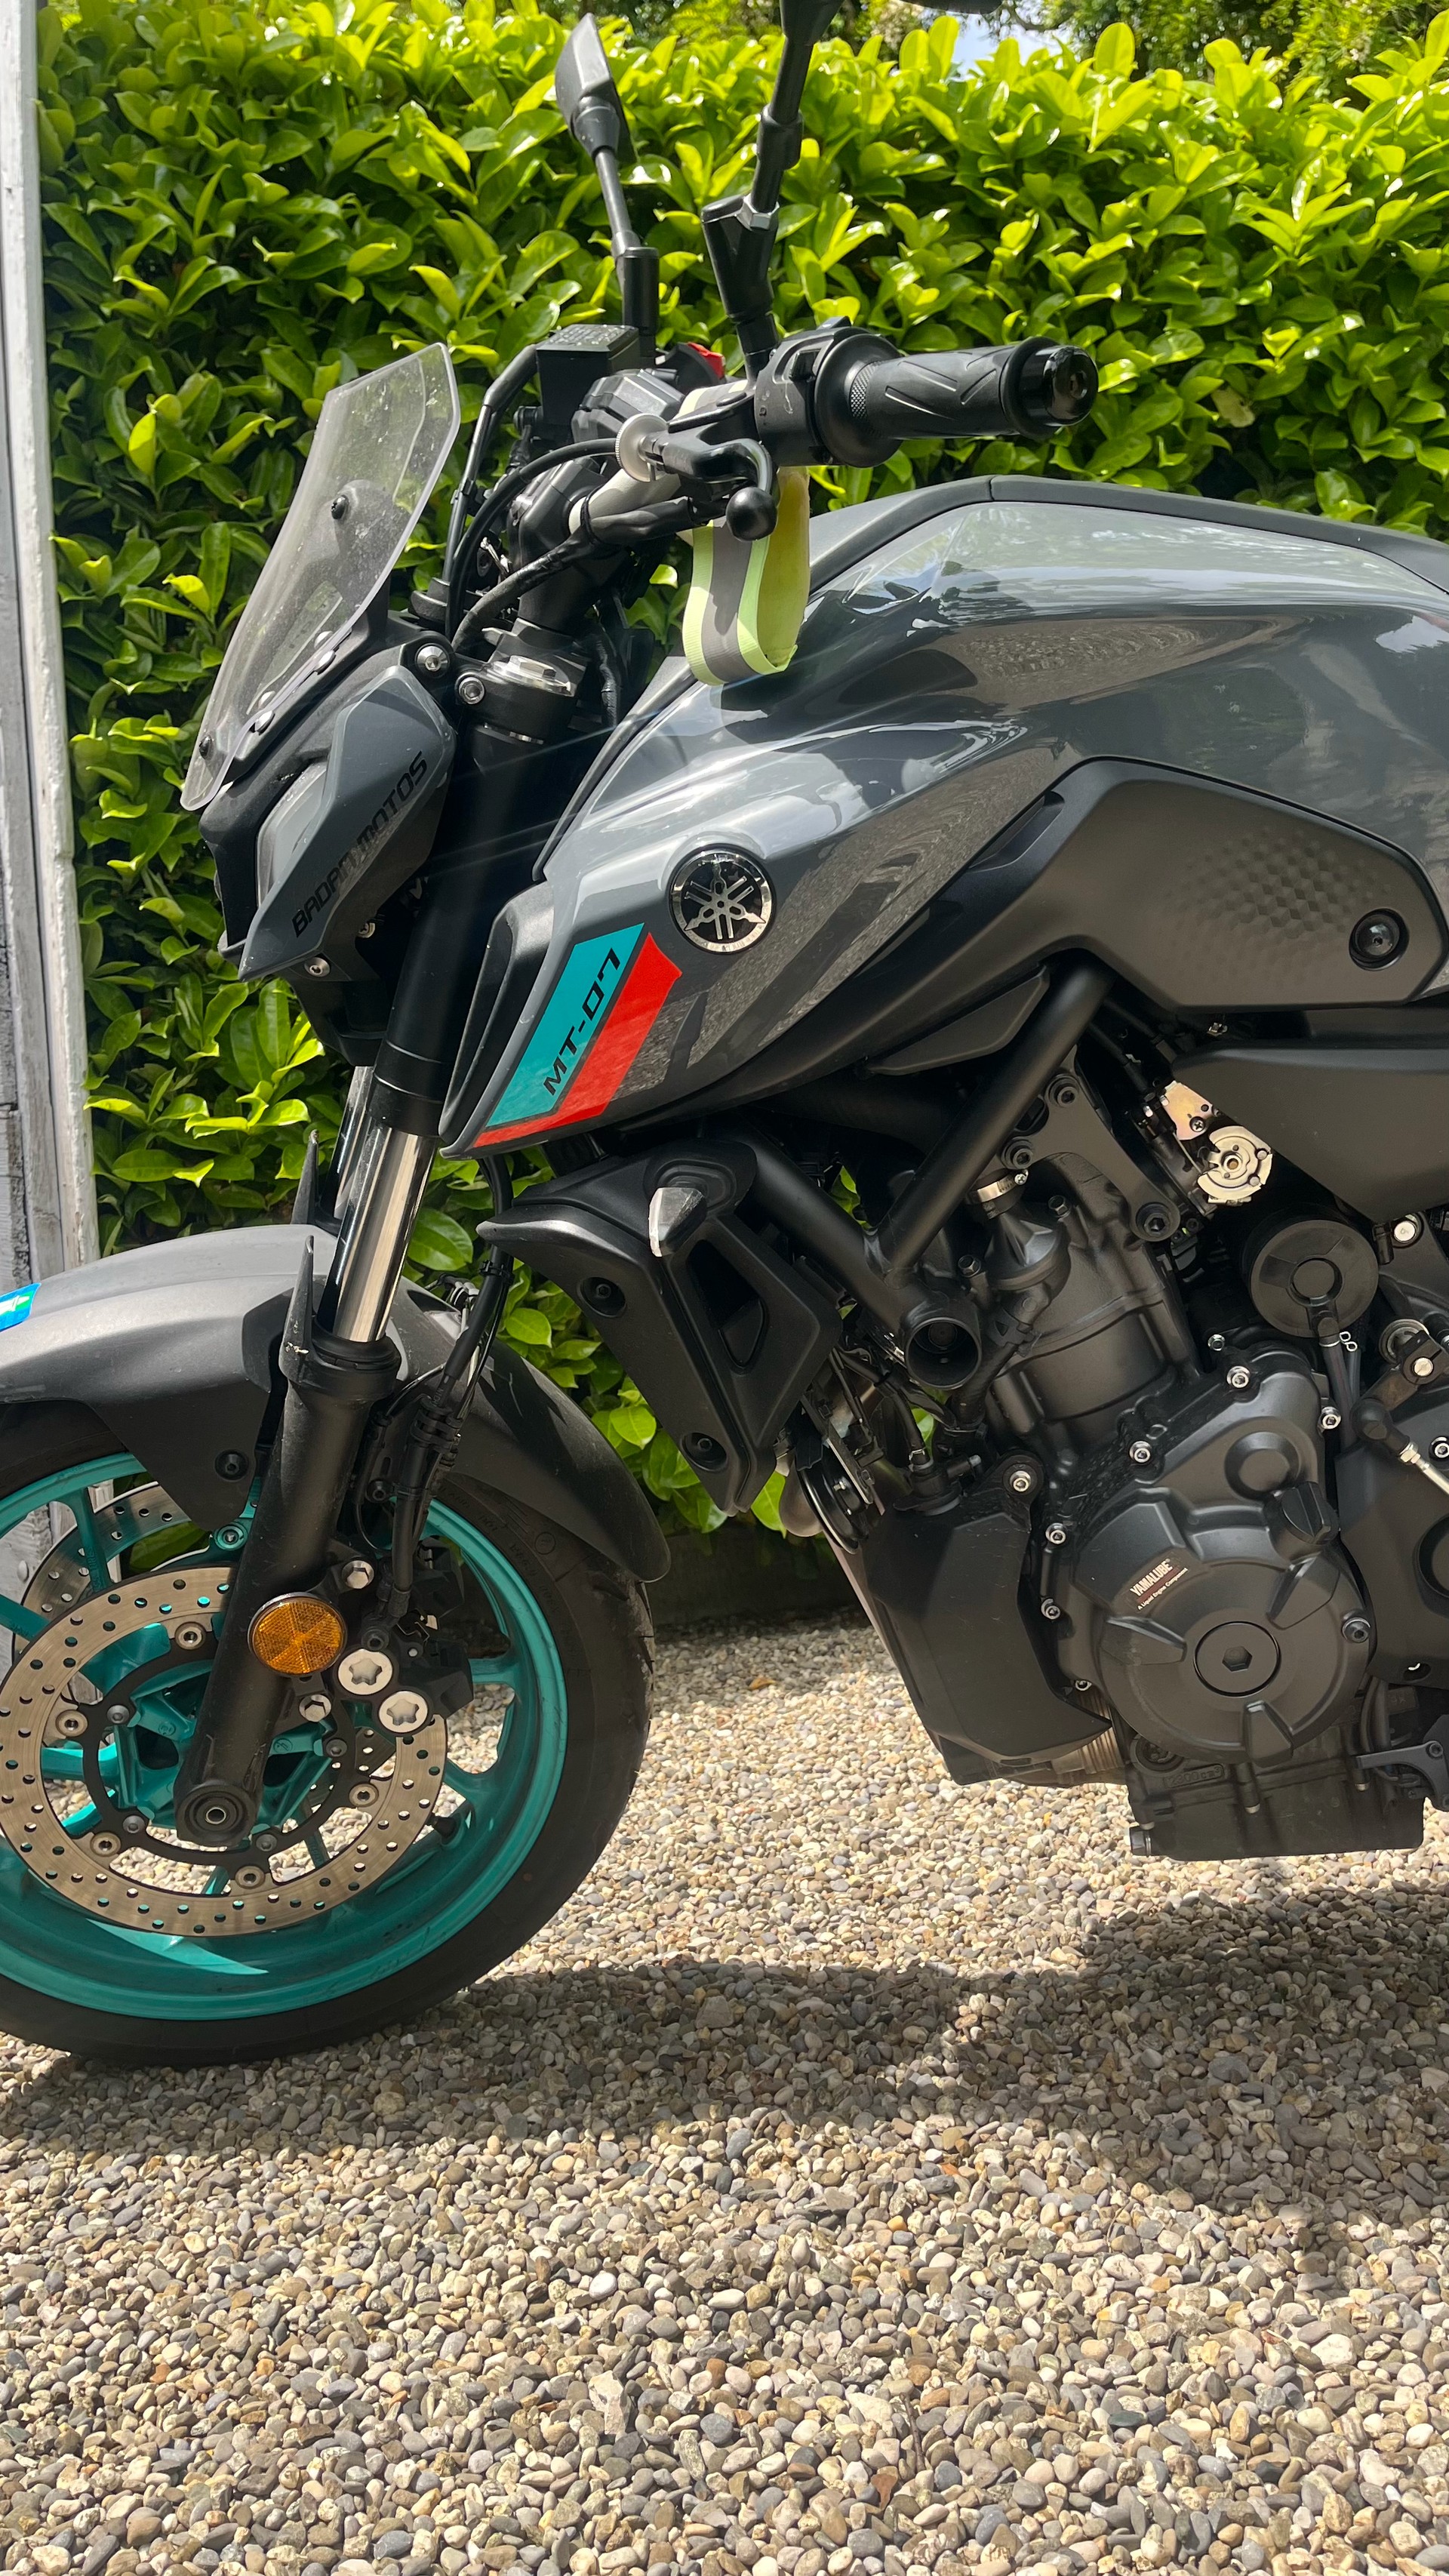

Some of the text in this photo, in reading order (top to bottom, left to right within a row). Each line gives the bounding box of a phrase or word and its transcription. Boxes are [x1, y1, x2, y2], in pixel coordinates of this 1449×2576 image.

[356, 751, 427, 852] MOTOS
[543, 947, 620, 1095] MT-07
[1130, 1560, 1174, 1596] YAMALUBE
